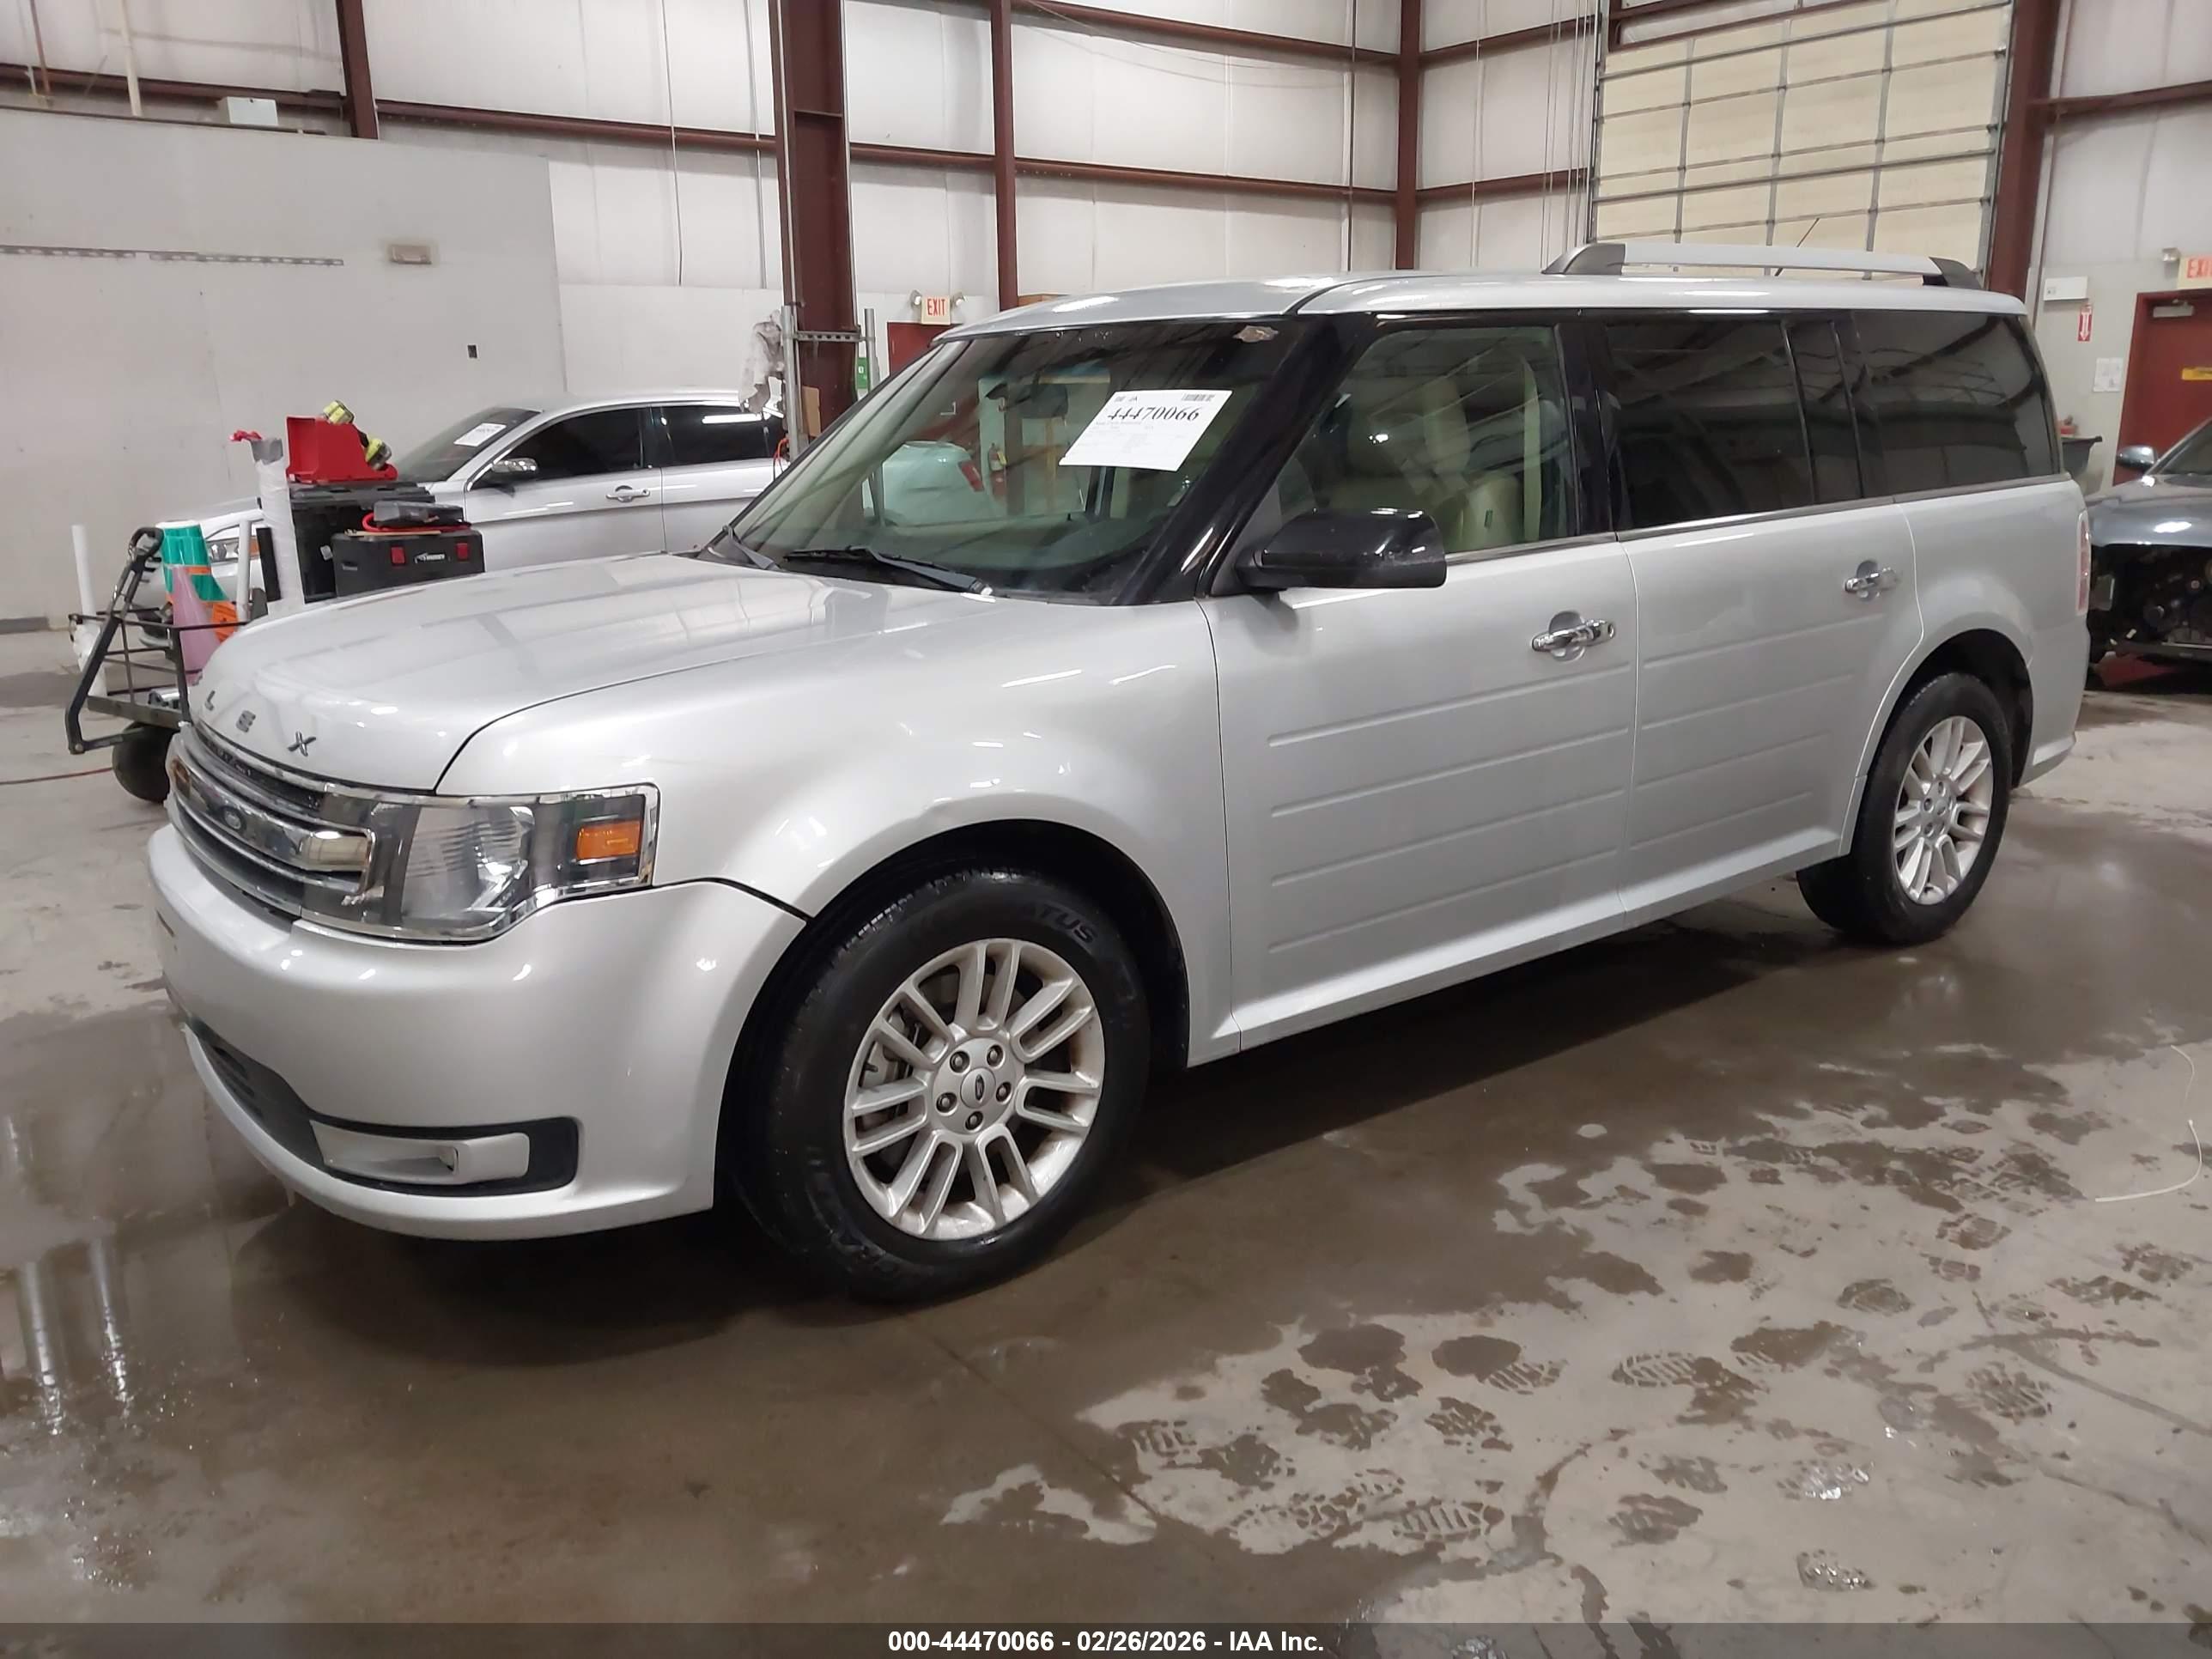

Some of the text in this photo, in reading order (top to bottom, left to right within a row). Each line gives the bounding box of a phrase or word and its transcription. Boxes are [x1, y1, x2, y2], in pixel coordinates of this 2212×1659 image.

[2187, 258, 2212, 278] EXI
[927, 298, 945, 316] EXIT
[1108, 407, 1199, 420] 44470066
[1040, 902, 1098, 944] TUS
